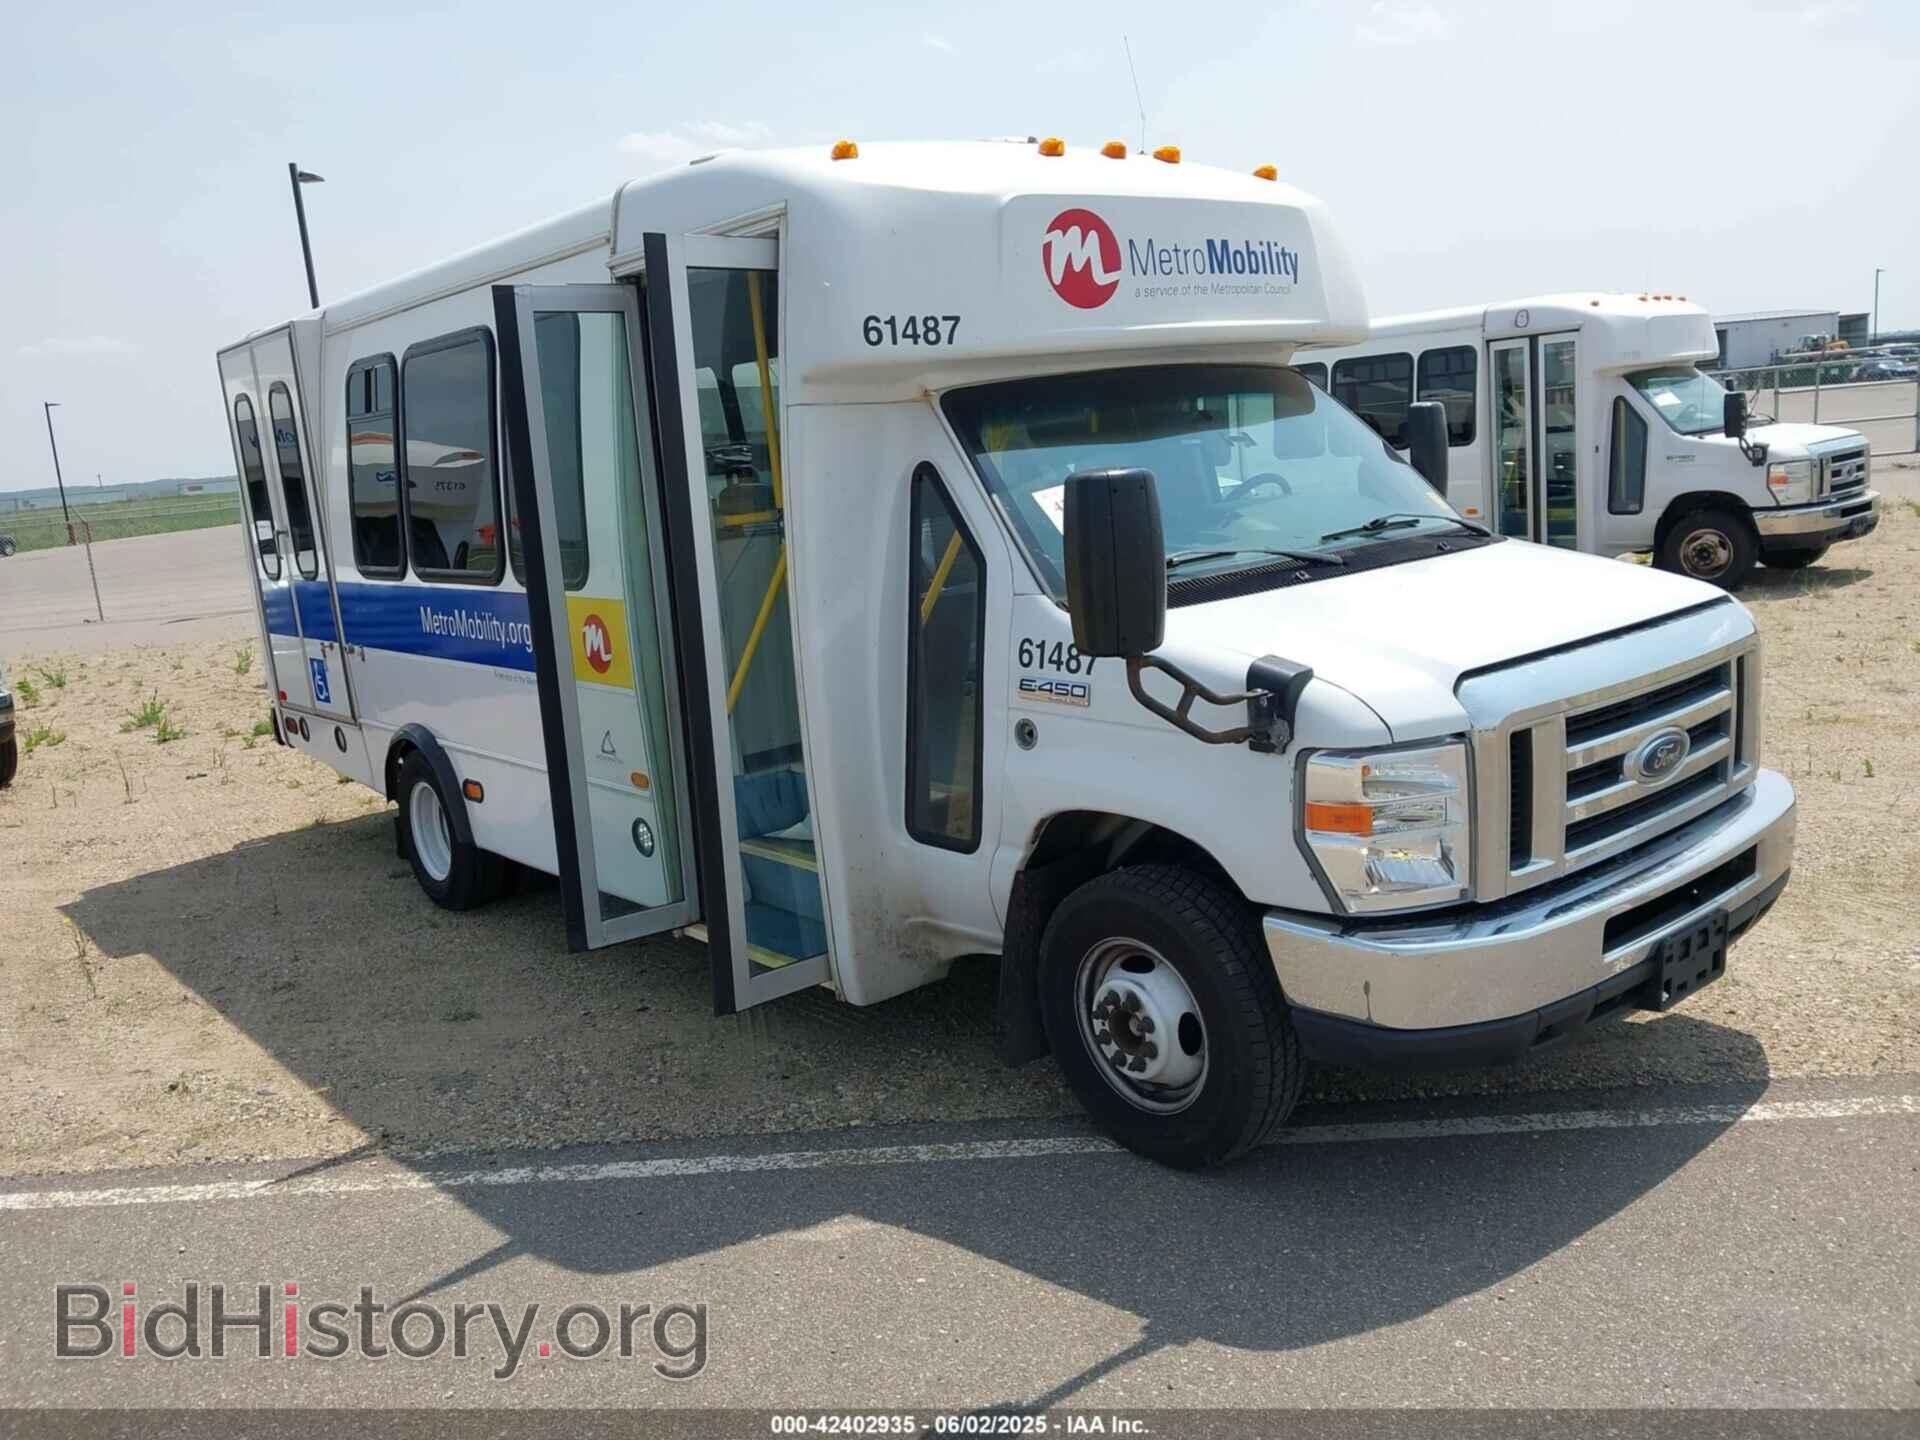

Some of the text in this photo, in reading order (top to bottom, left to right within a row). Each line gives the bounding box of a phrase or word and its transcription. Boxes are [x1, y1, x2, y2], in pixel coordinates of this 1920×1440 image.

[1128, 238, 1299, 285] MetroMobility
[1143, 286, 1179, 297] service
[1181, 285, 1191, 296] of
[1193, 283, 1208, 296] the
[1210, 282, 1262, 296] Metropolitan
[863, 314, 961, 346] 61487
[420, 606, 534, 653] MetroMobility.org
